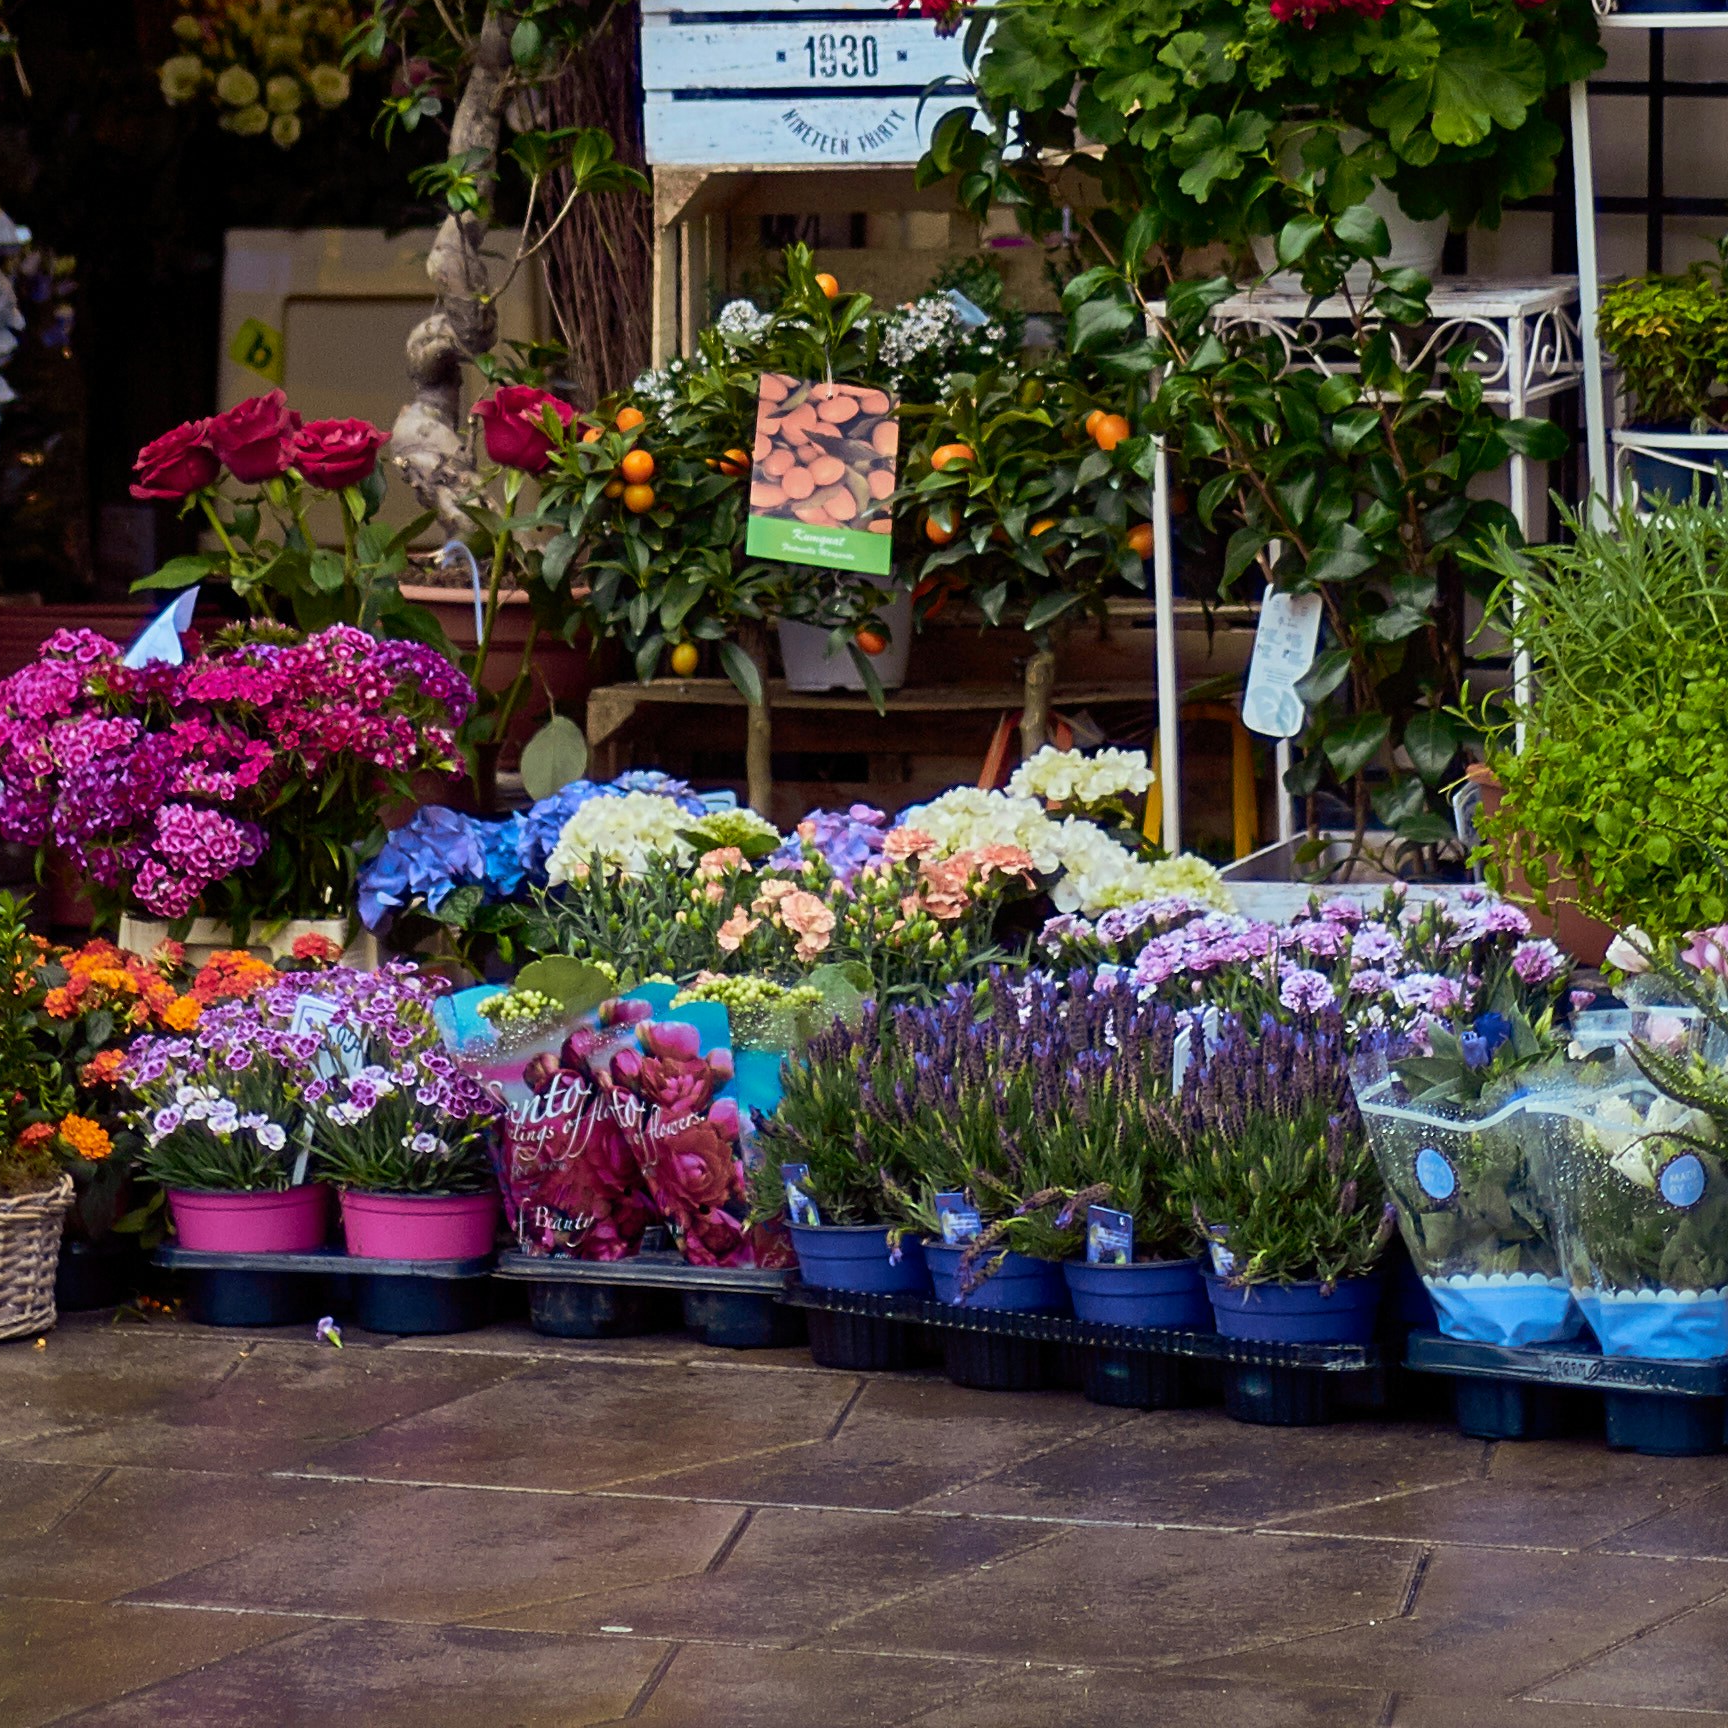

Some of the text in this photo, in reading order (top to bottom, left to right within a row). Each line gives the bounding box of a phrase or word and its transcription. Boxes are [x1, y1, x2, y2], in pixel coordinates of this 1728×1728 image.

[804, 34, 879, 78] 1930
[781, 108, 906, 155] NINETEEN THIRTY
[792, 527, 846, 547] Kumquat
